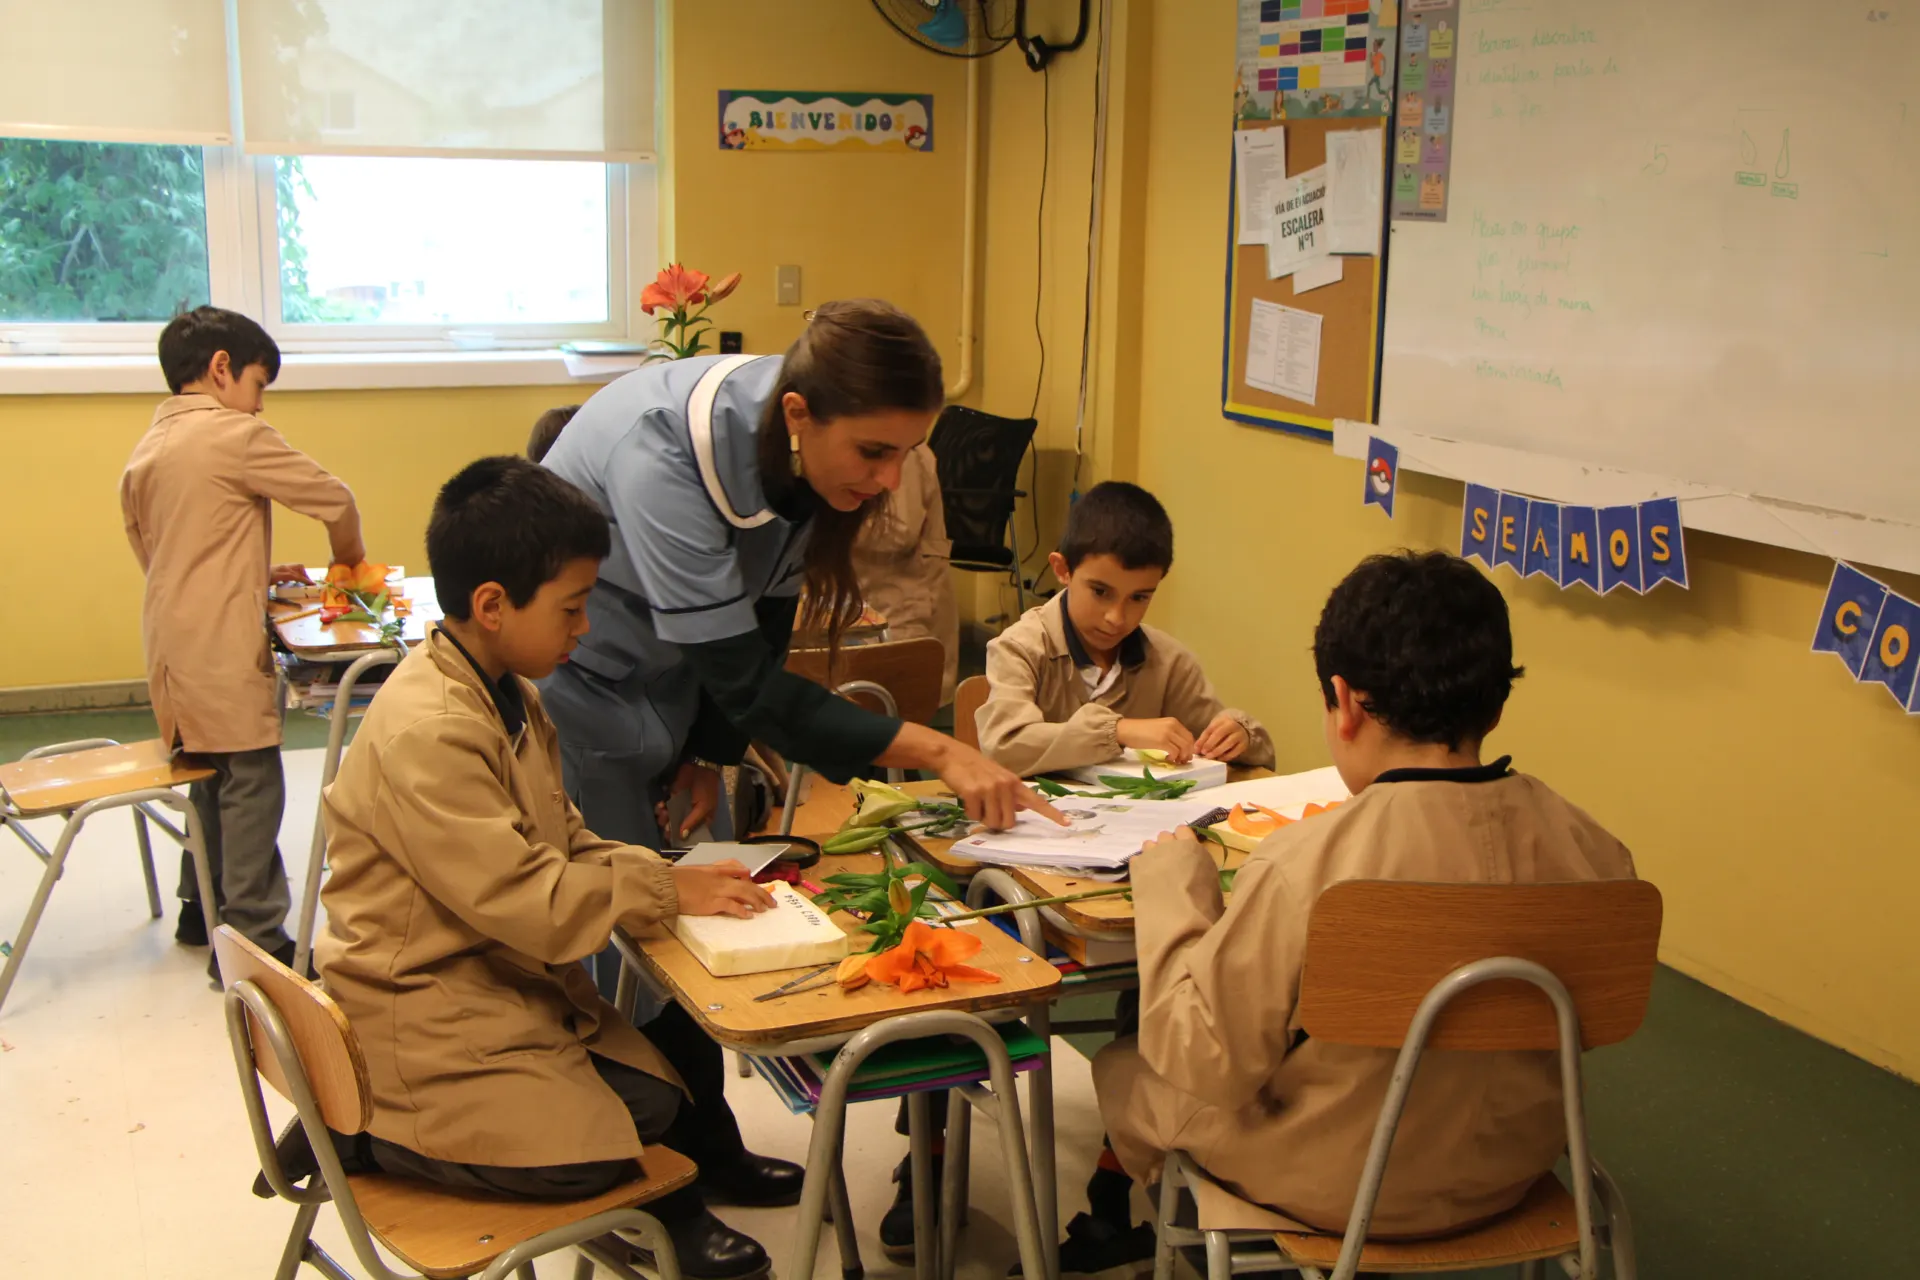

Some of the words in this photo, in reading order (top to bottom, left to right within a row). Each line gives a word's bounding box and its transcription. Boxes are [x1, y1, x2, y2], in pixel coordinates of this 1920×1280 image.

[750, 110, 905, 131] BIENVENIDOS
[1276, 201, 1285, 215] VÍA
[1286, 198, 1294, 212] DE
[1281, 207, 1324, 238] ESCALERA
[1471, 507, 1671, 568] SEAMOS
[1835, 600, 1910, 668] CO
